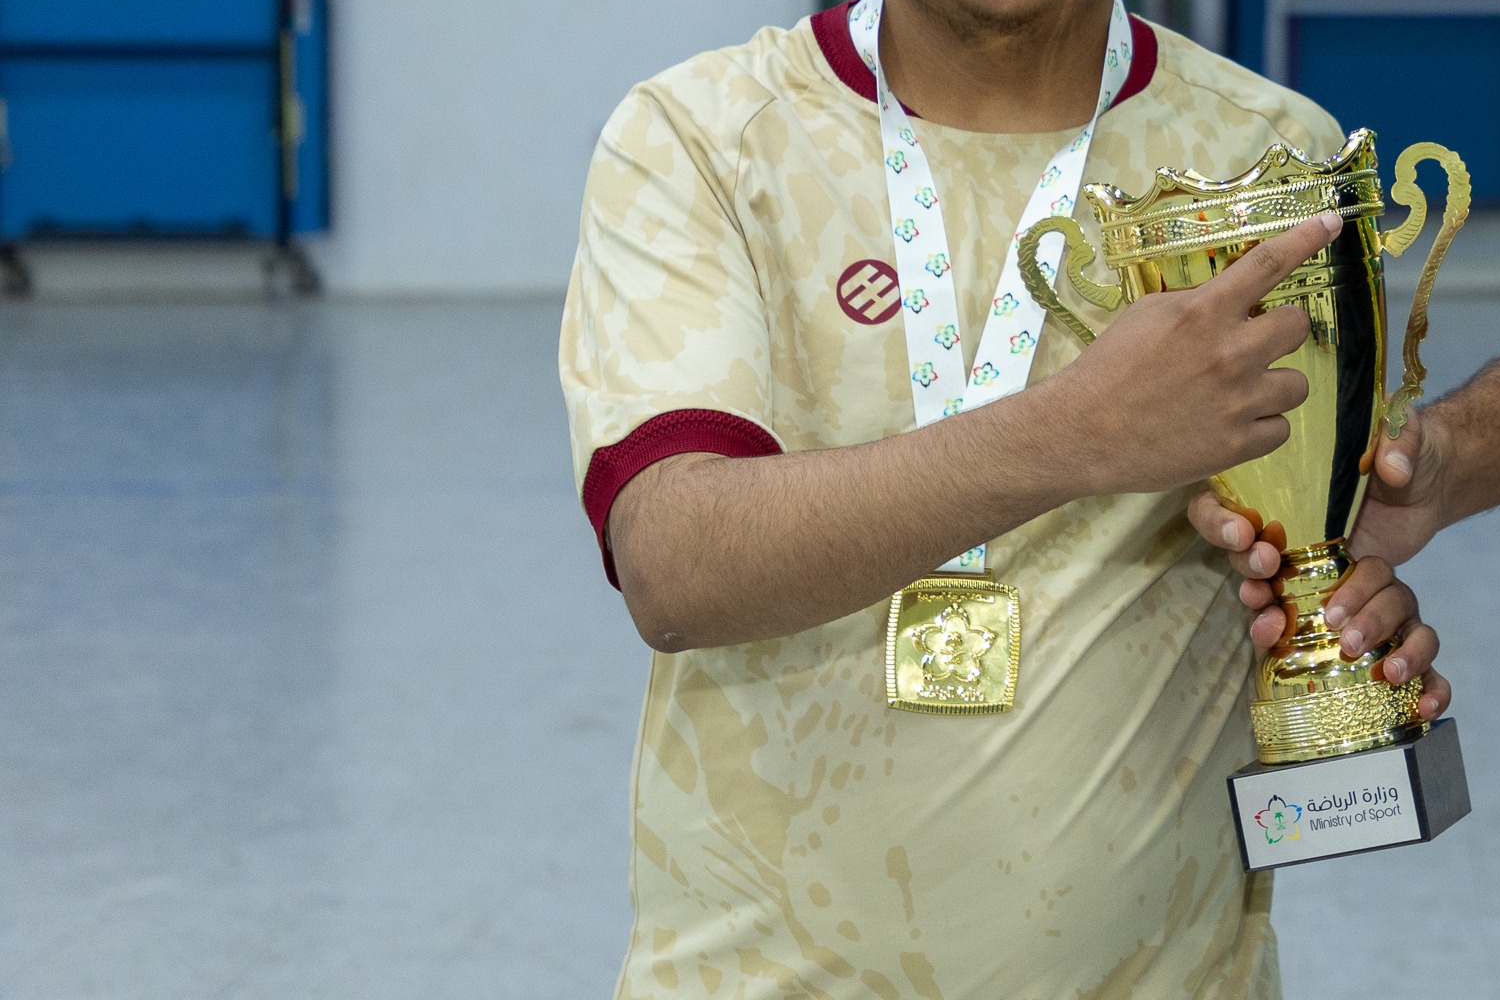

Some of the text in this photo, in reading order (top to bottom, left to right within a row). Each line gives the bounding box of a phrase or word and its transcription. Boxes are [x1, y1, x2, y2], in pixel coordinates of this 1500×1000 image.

[1307, 786, 1398, 812] وزارة الرياضة
[1309, 803, 1402, 832] Ministry of Sport
